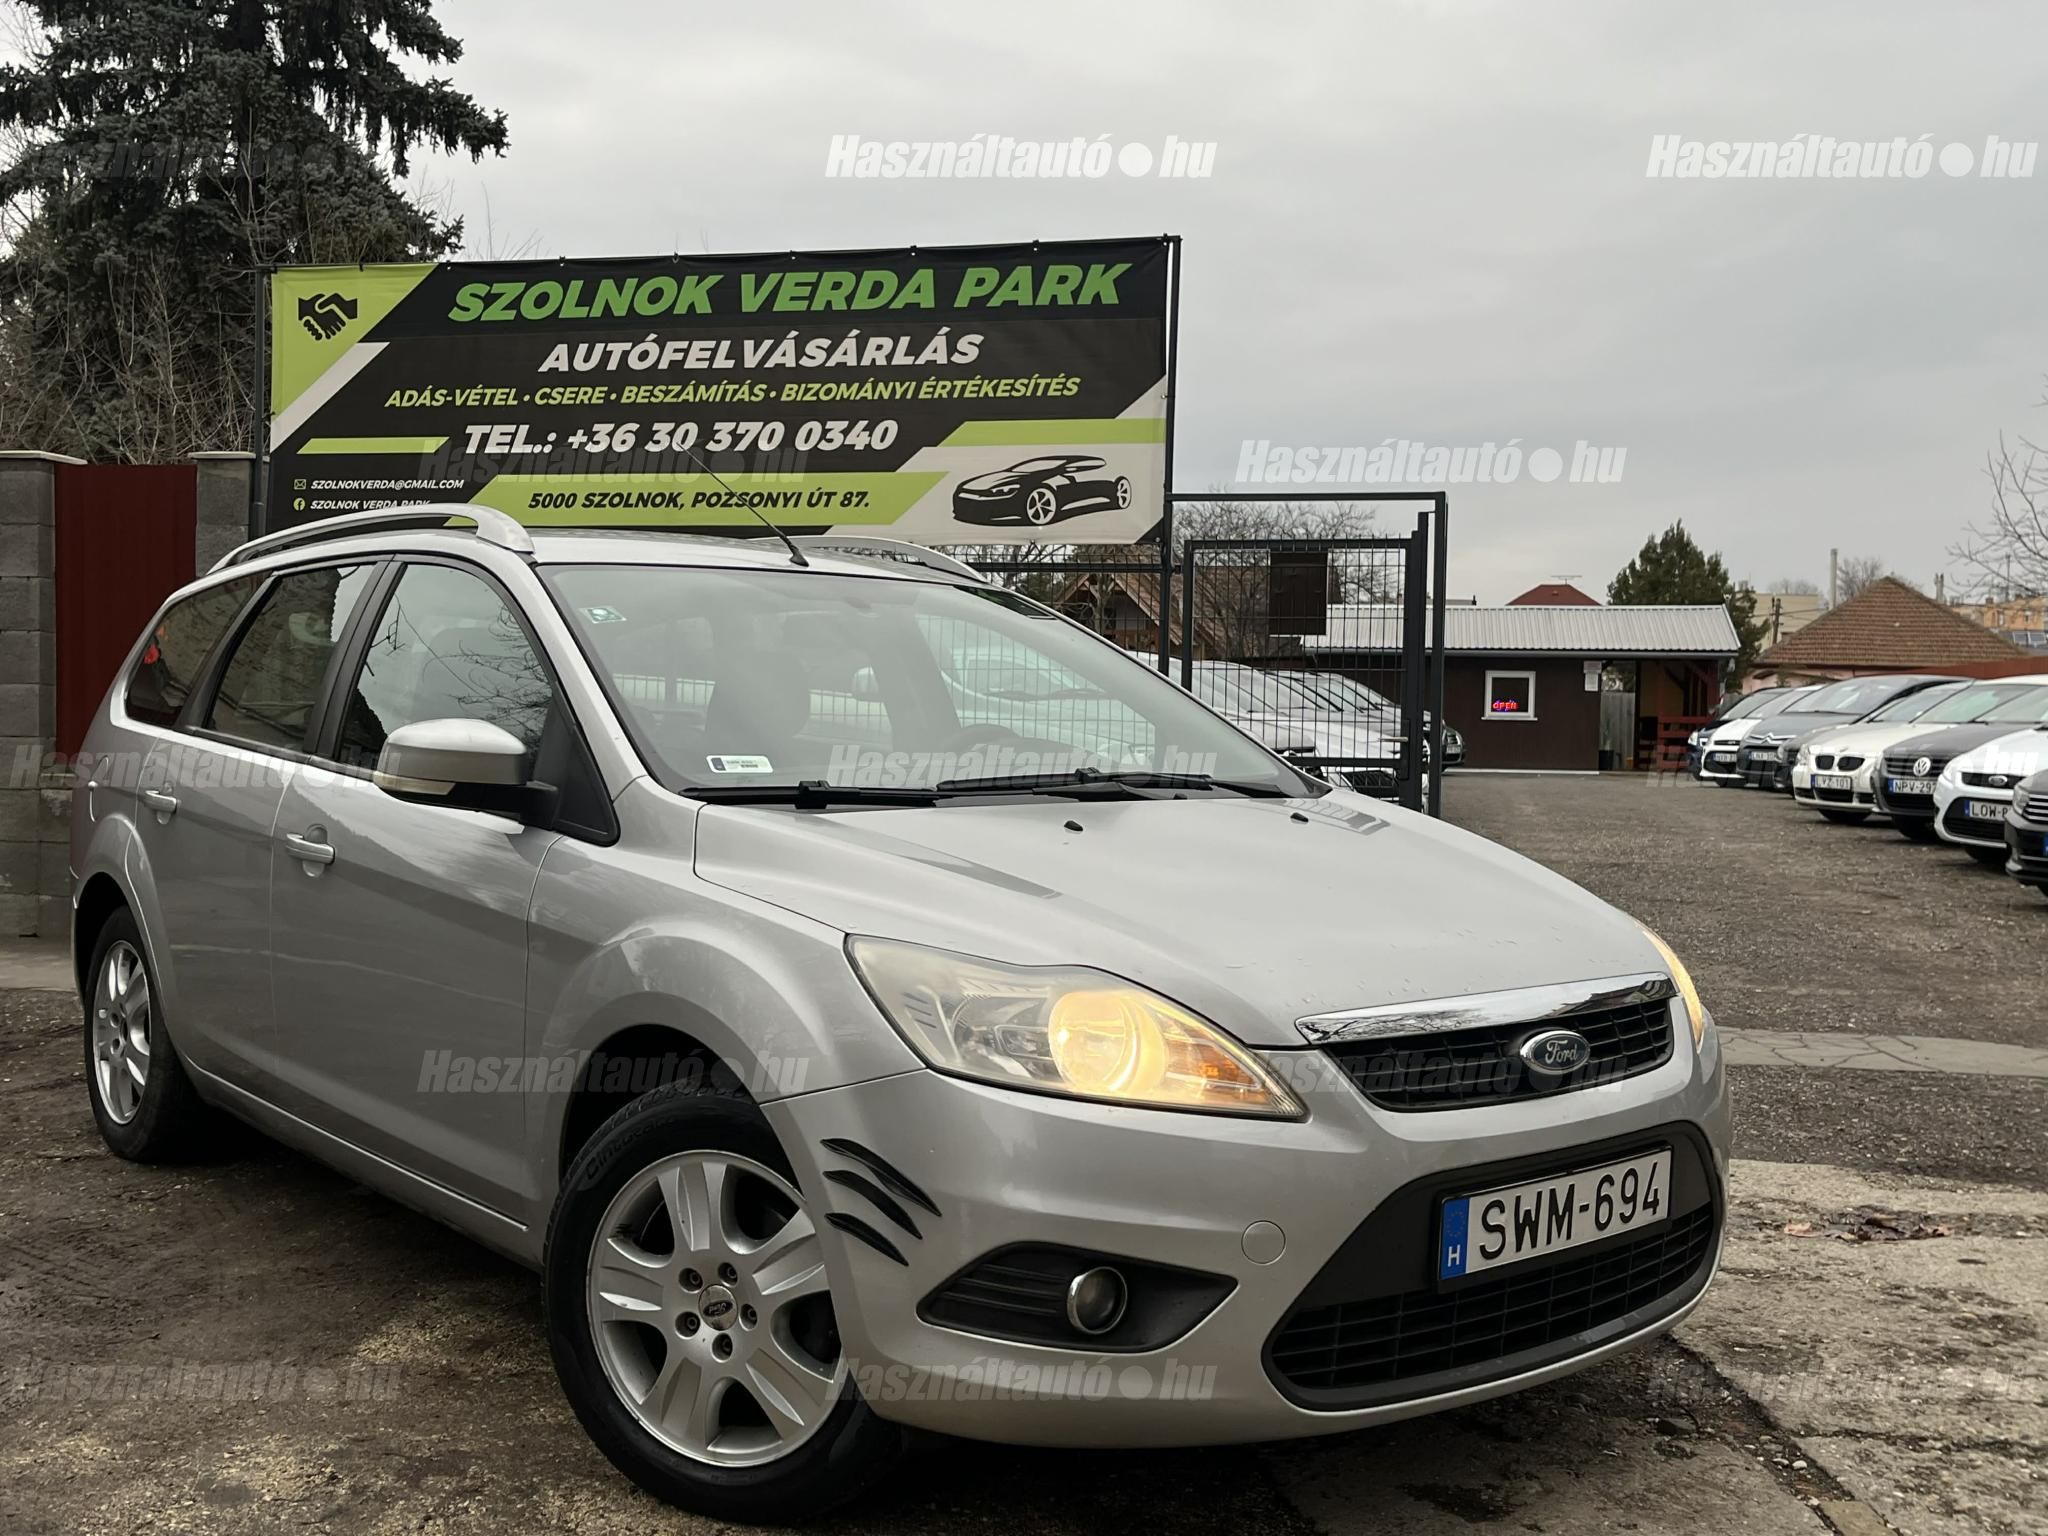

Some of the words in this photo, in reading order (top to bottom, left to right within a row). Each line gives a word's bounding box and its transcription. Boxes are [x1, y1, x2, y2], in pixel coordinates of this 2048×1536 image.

[447, 274, 724, 322] SZOLNOK
[740, 268, 935, 313] VERDA
[954, 263, 1134, 308] PARK
[538, 326, 984, 372] AUTÓFELVÁSÁRLÁS
[384, 385, 518, 407] ADÁS-VÉTEL
[534, 386, 607, 406] CSERE
[620, 379, 767, 404] BESZÁMÍTÁS
[780, 378, 914, 401] BIZOMÁNYI
[918, 375, 1081, 399] ÉRTÉKESÍTÉS
[463, 424, 556, 454] TEL.:
[567, 423, 640, 453] +36
[645, 422, 699, 452] 30
[705, 421, 784, 451] 370
[795, 420, 898, 450] 0340
[311, 480, 464, 491] SZOLNOKVERDA@GMAIL.COM
[528, 492, 576, 509] 5000
[581, 491, 686, 511] SZOLNOK,
[691, 491, 803, 509] POZSONYI
[806, 486, 838, 508] ÚT
[839, 491, 870, 508] 87.
[310, 500, 360, 510] SZOLNOK
[363, 500, 398, 509] VERDA
[1545, 1040, 1580, 1064] Ford
[1479, 1161, 1661, 1261] SWM-694
[1446, 1246, 1461, 1268] H
